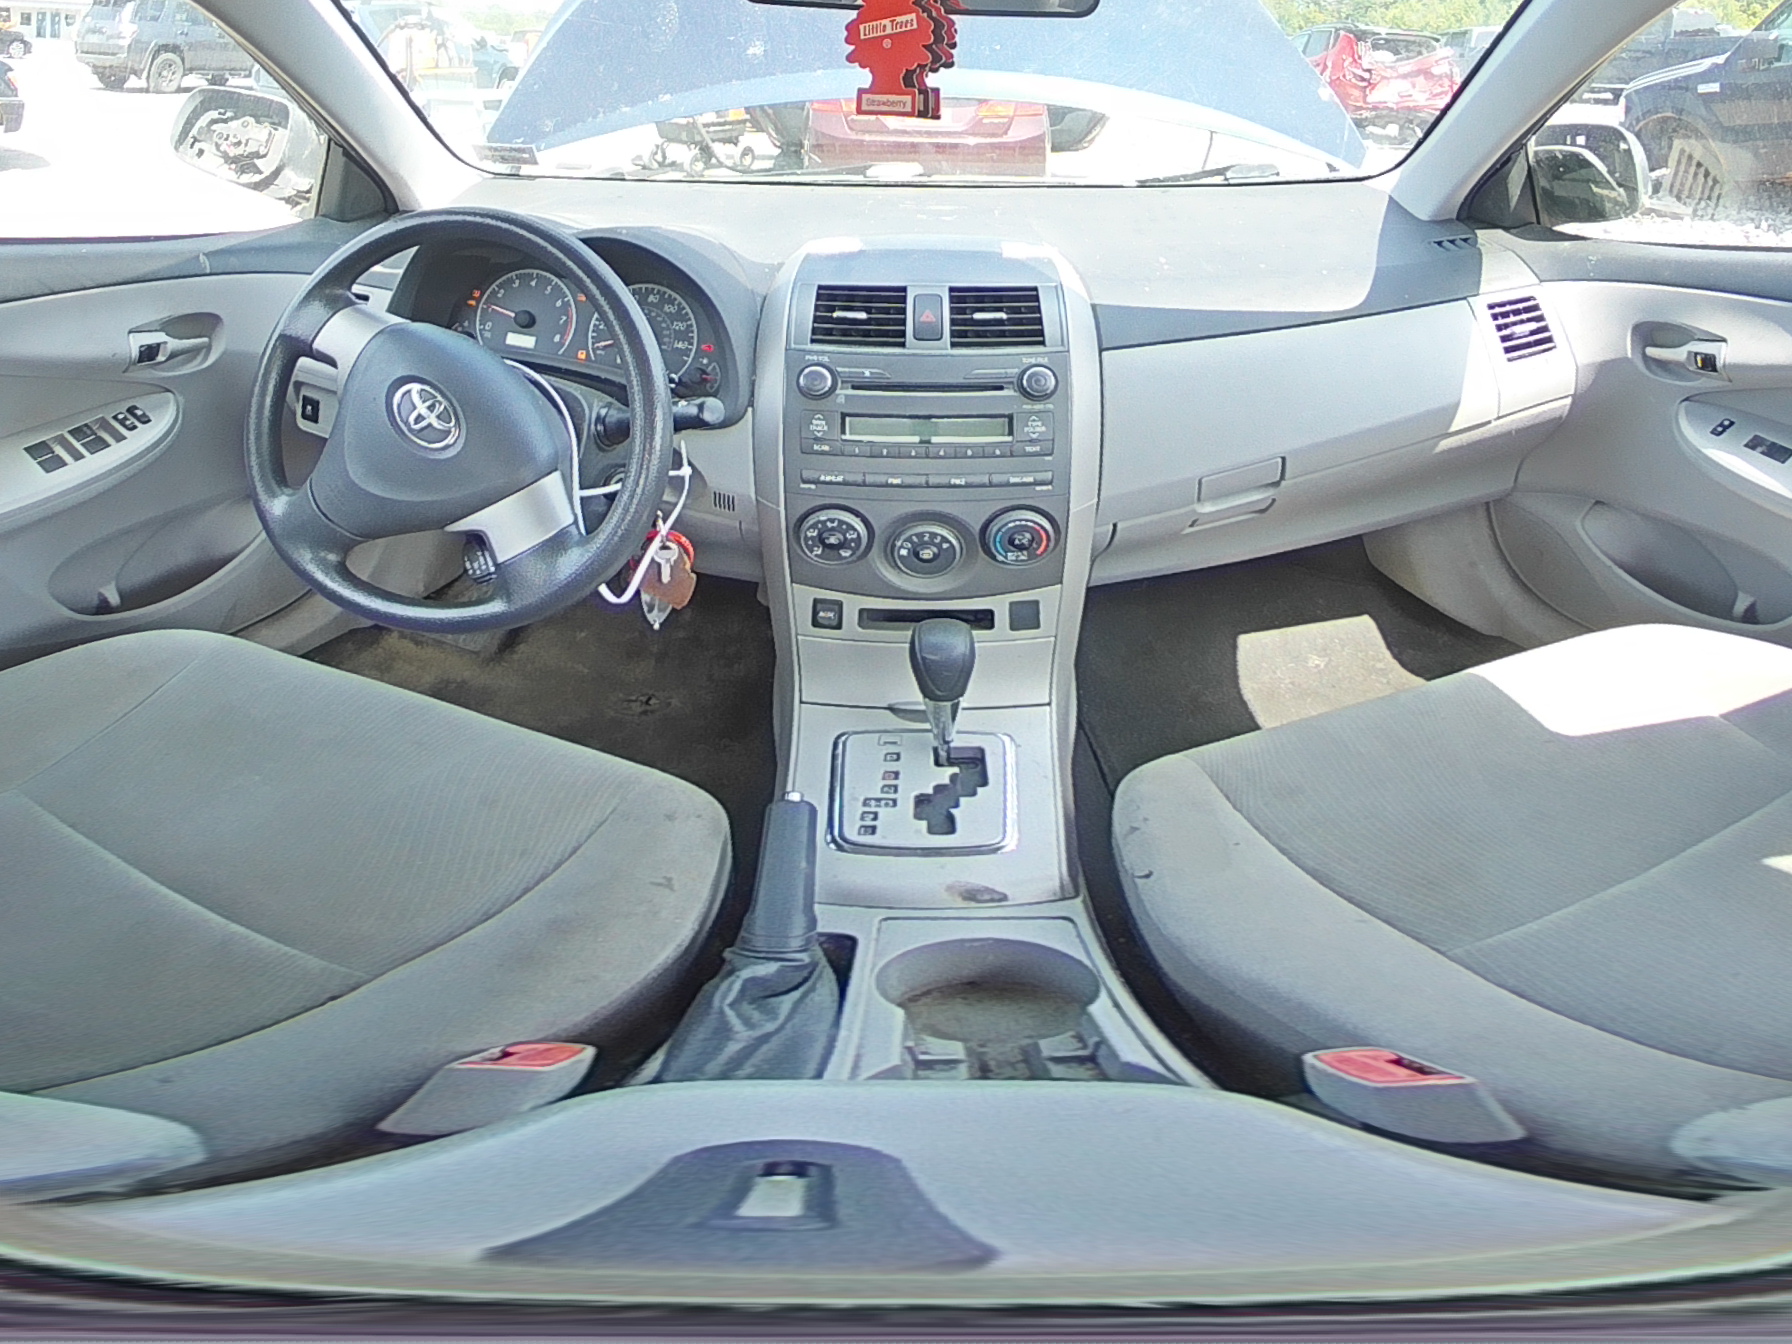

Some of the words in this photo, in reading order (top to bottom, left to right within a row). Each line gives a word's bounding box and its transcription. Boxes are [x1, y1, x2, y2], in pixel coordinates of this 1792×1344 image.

[862, 22, 888, 38] Little
[888, 17, 915, 33] Trees
[865, 96, 908, 110] Strawberry
